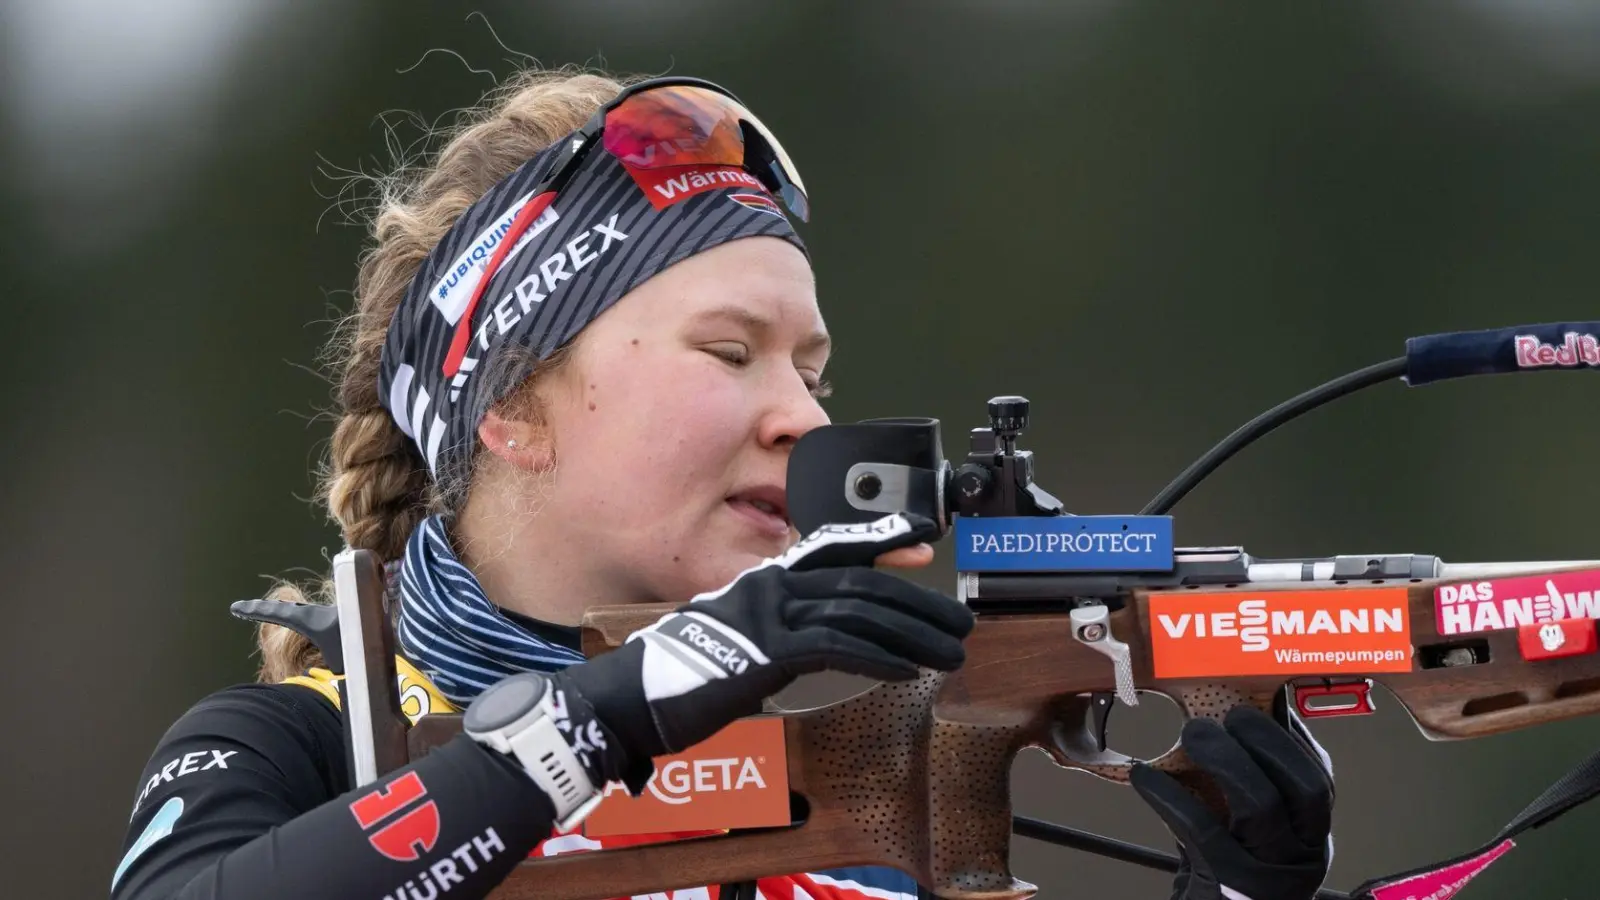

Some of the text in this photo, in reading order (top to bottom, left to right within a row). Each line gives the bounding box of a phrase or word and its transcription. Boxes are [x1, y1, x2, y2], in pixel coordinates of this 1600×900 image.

[438, 207, 523, 299] #UBIQUIN
[475, 213, 629, 351] TERREX
[1515, 332, 1577, 367] Red
[1439, 581, 1494, 605] DAS
[1157, 600, 1403, 652] VIESSMANN
[1275, 649, 1405, 665] Wärmepumpen
